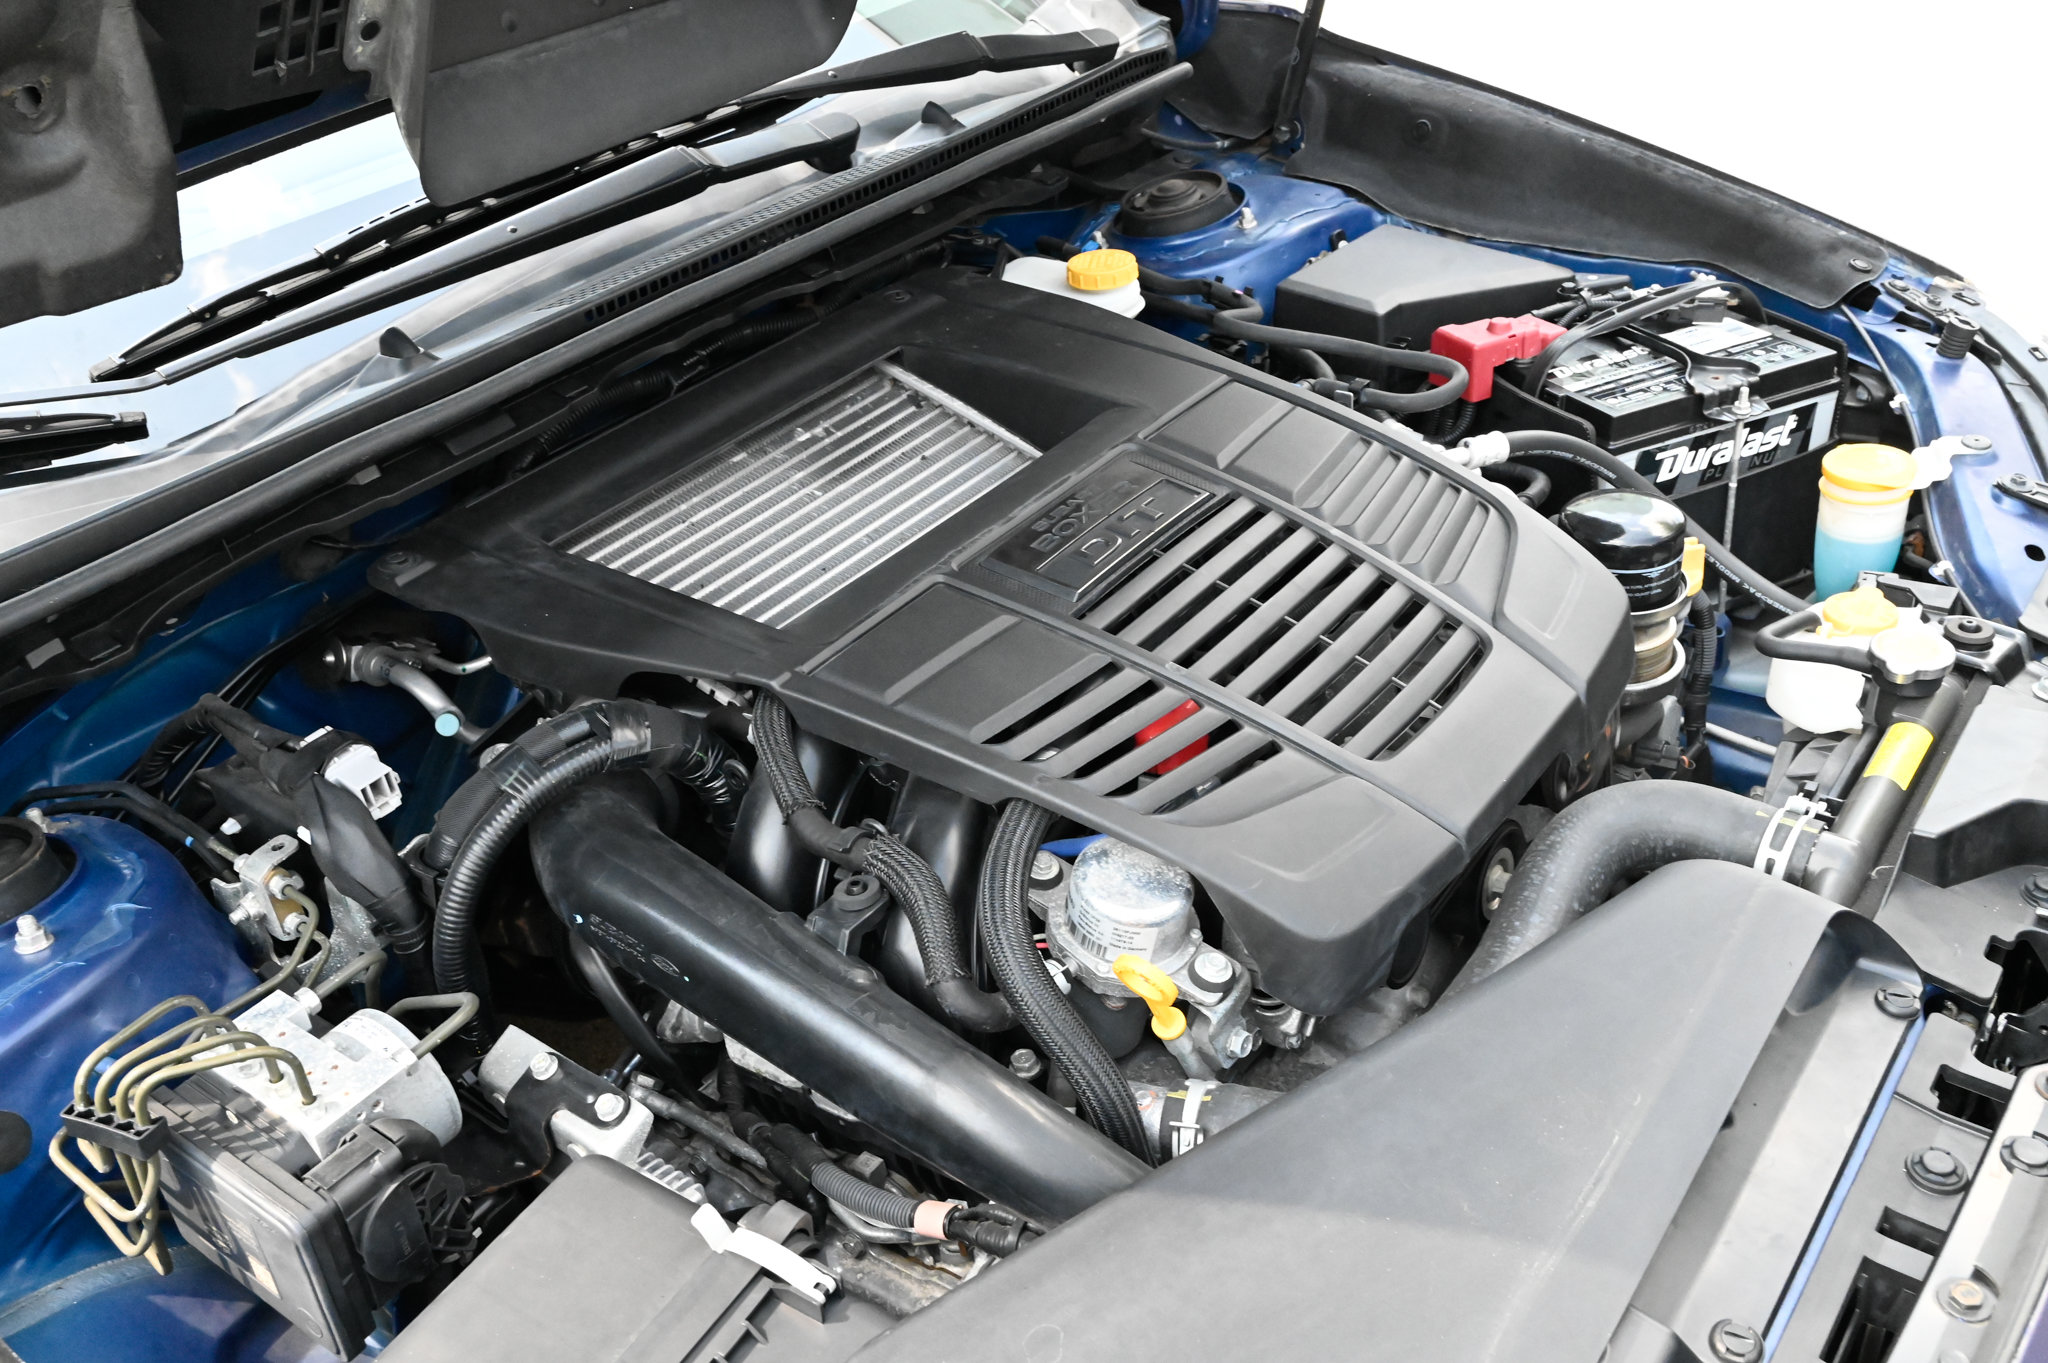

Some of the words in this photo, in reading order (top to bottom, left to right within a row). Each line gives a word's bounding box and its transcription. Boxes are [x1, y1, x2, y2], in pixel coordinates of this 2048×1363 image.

[1548, 345, 1651, 379] Duralast
[1655, 414, 1799, 483] Duralast
[1070, 496, 1164, 567] DIT
